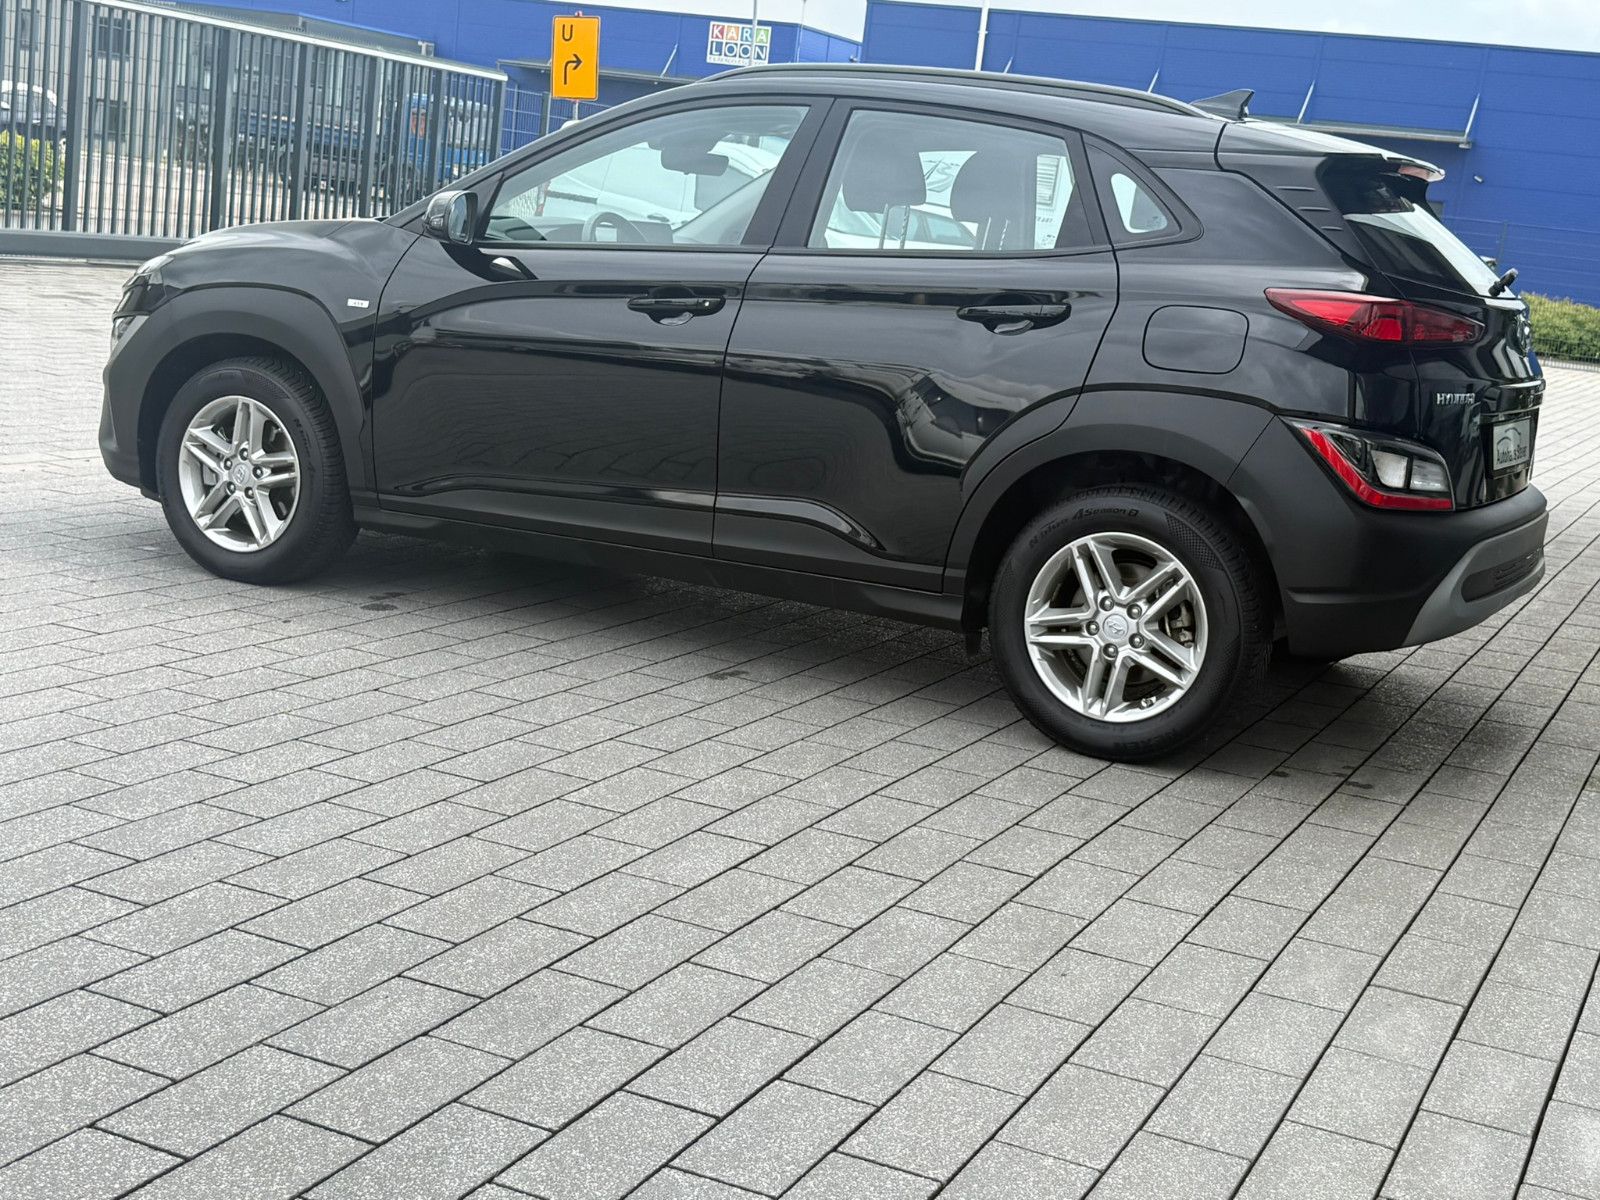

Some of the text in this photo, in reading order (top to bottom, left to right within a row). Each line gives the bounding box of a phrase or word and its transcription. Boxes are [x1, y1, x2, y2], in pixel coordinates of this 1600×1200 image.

[561, 23, 574, 42] U
[712, 25, 768, 43] KARA
[711, 41, 767, 60] LOON
